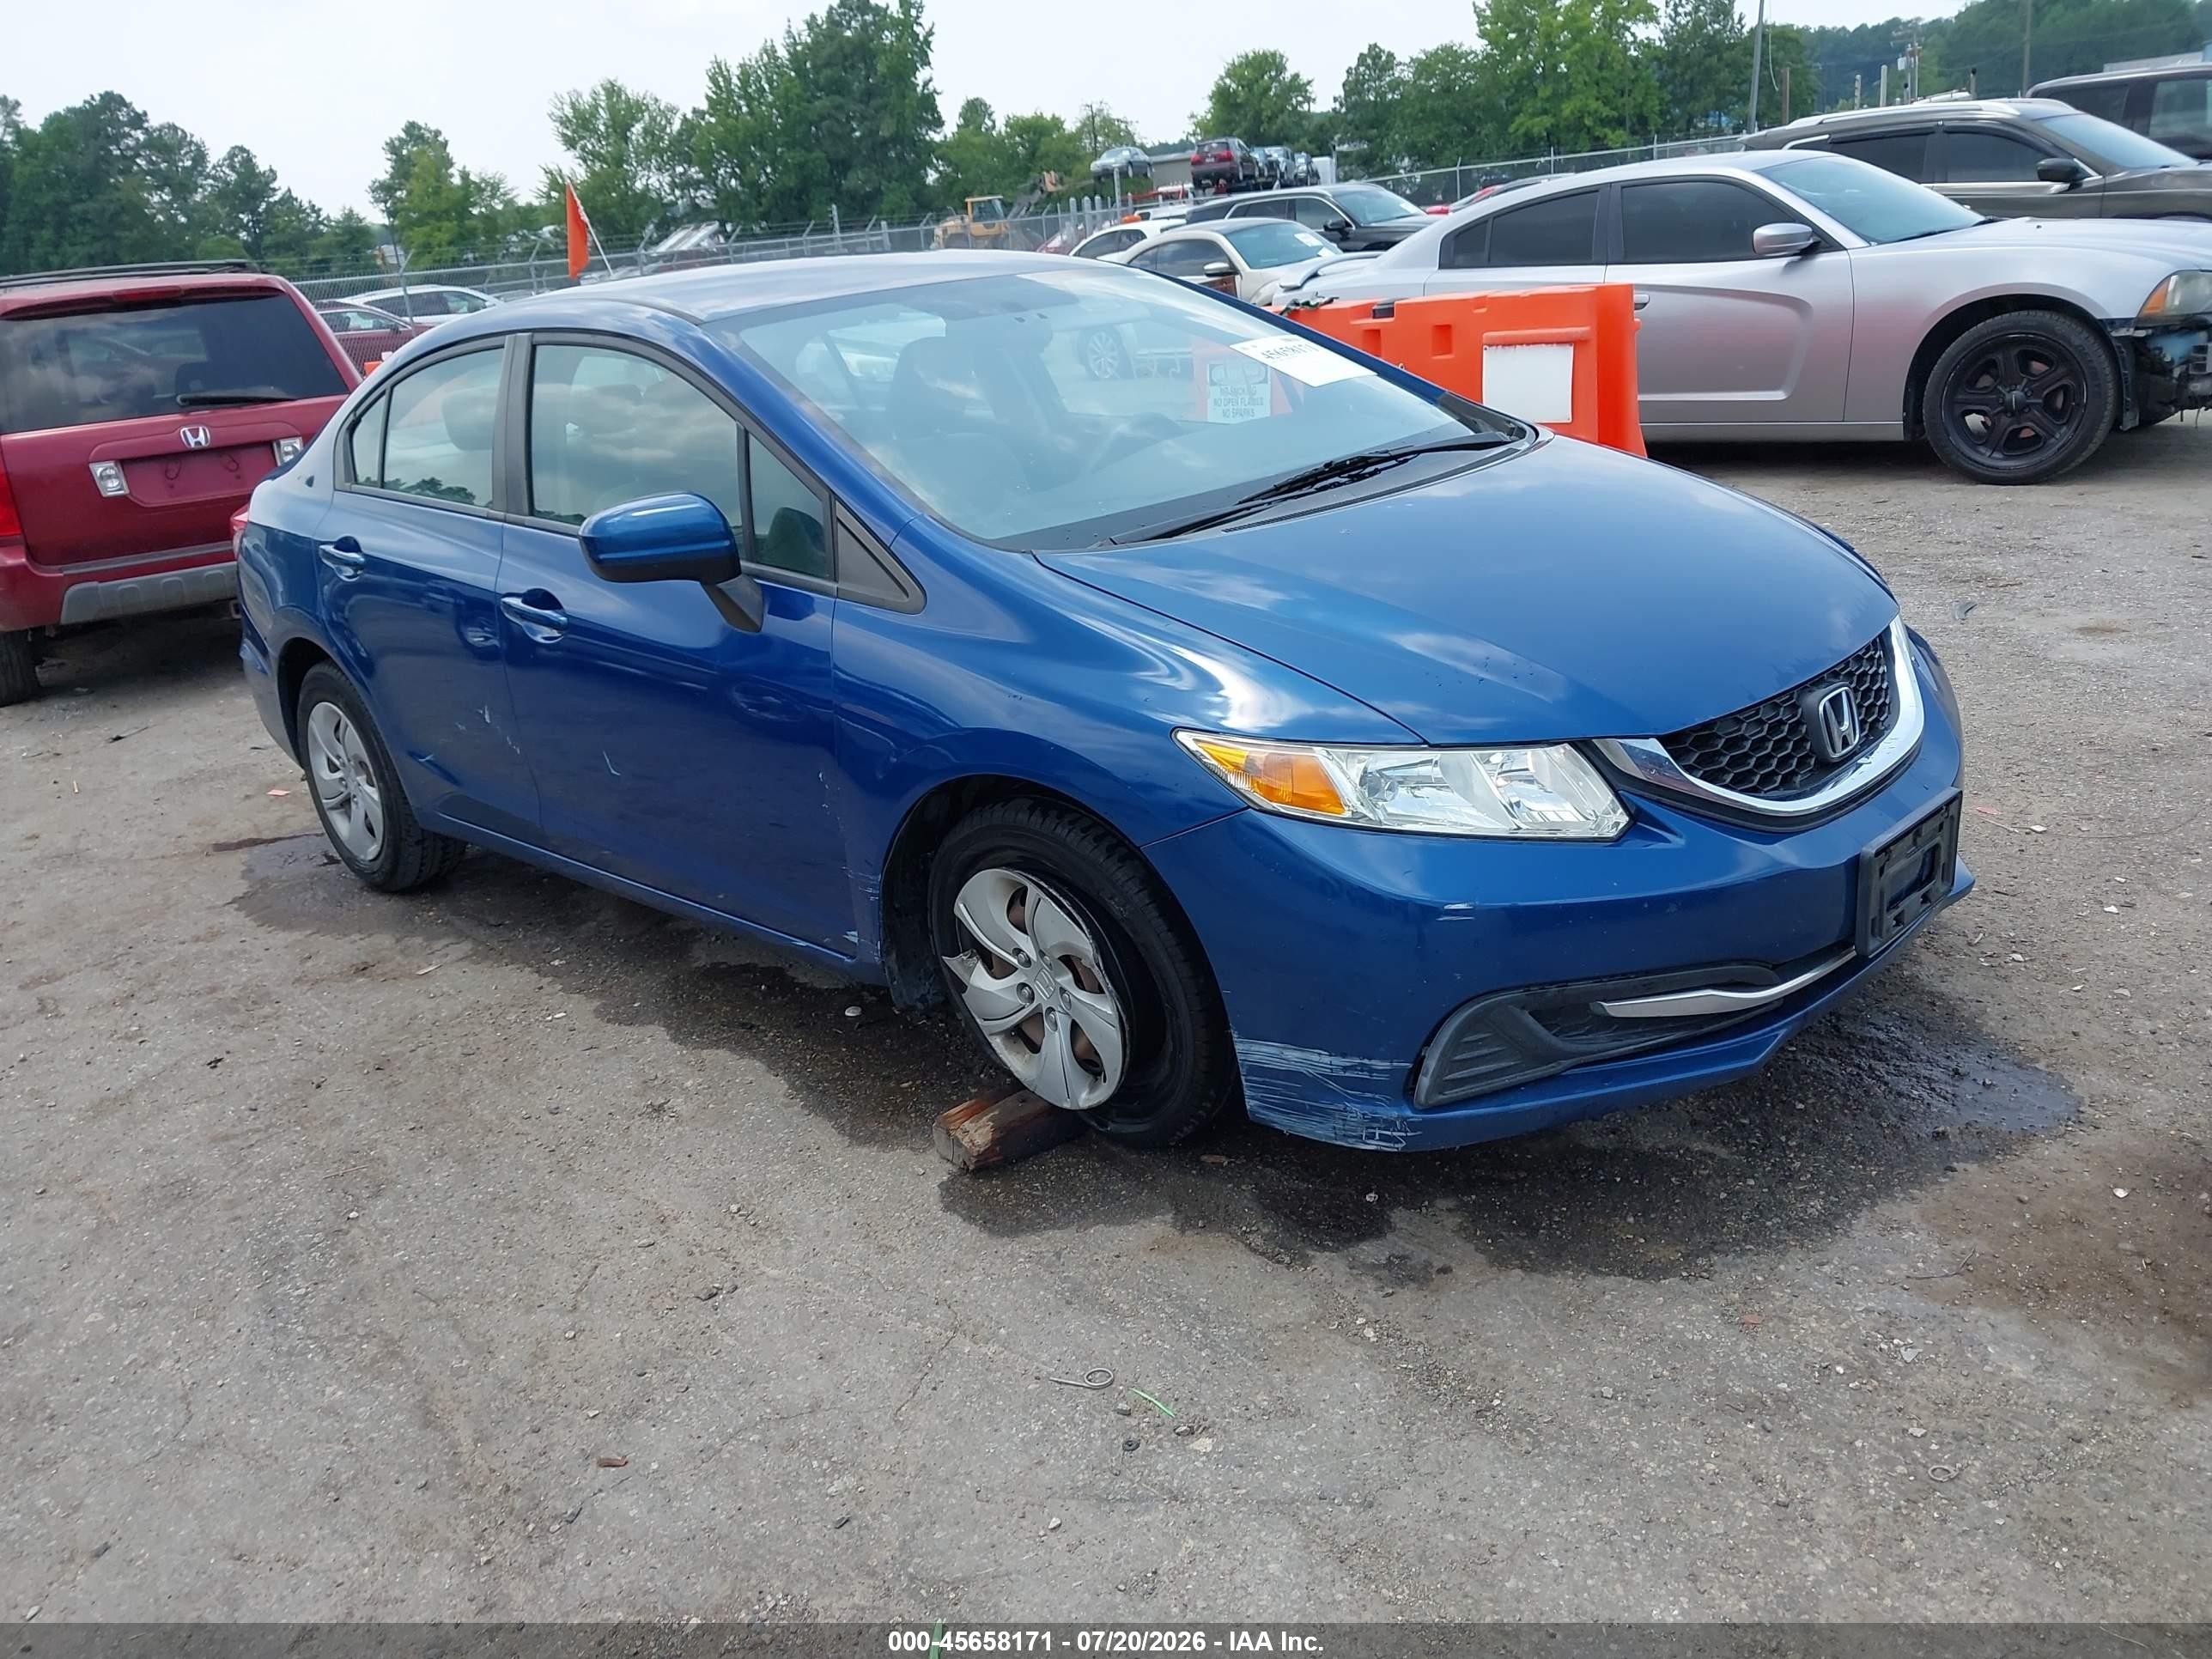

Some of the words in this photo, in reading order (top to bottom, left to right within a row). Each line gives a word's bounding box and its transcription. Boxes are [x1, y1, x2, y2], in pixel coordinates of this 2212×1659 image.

[1230, 386, 1256, 396] SMOKNG
[1213, 398, 1222, 406] NO
[1224, 398, 1239, 406] OPEN
[1223, 408, 1231, 417] NO
